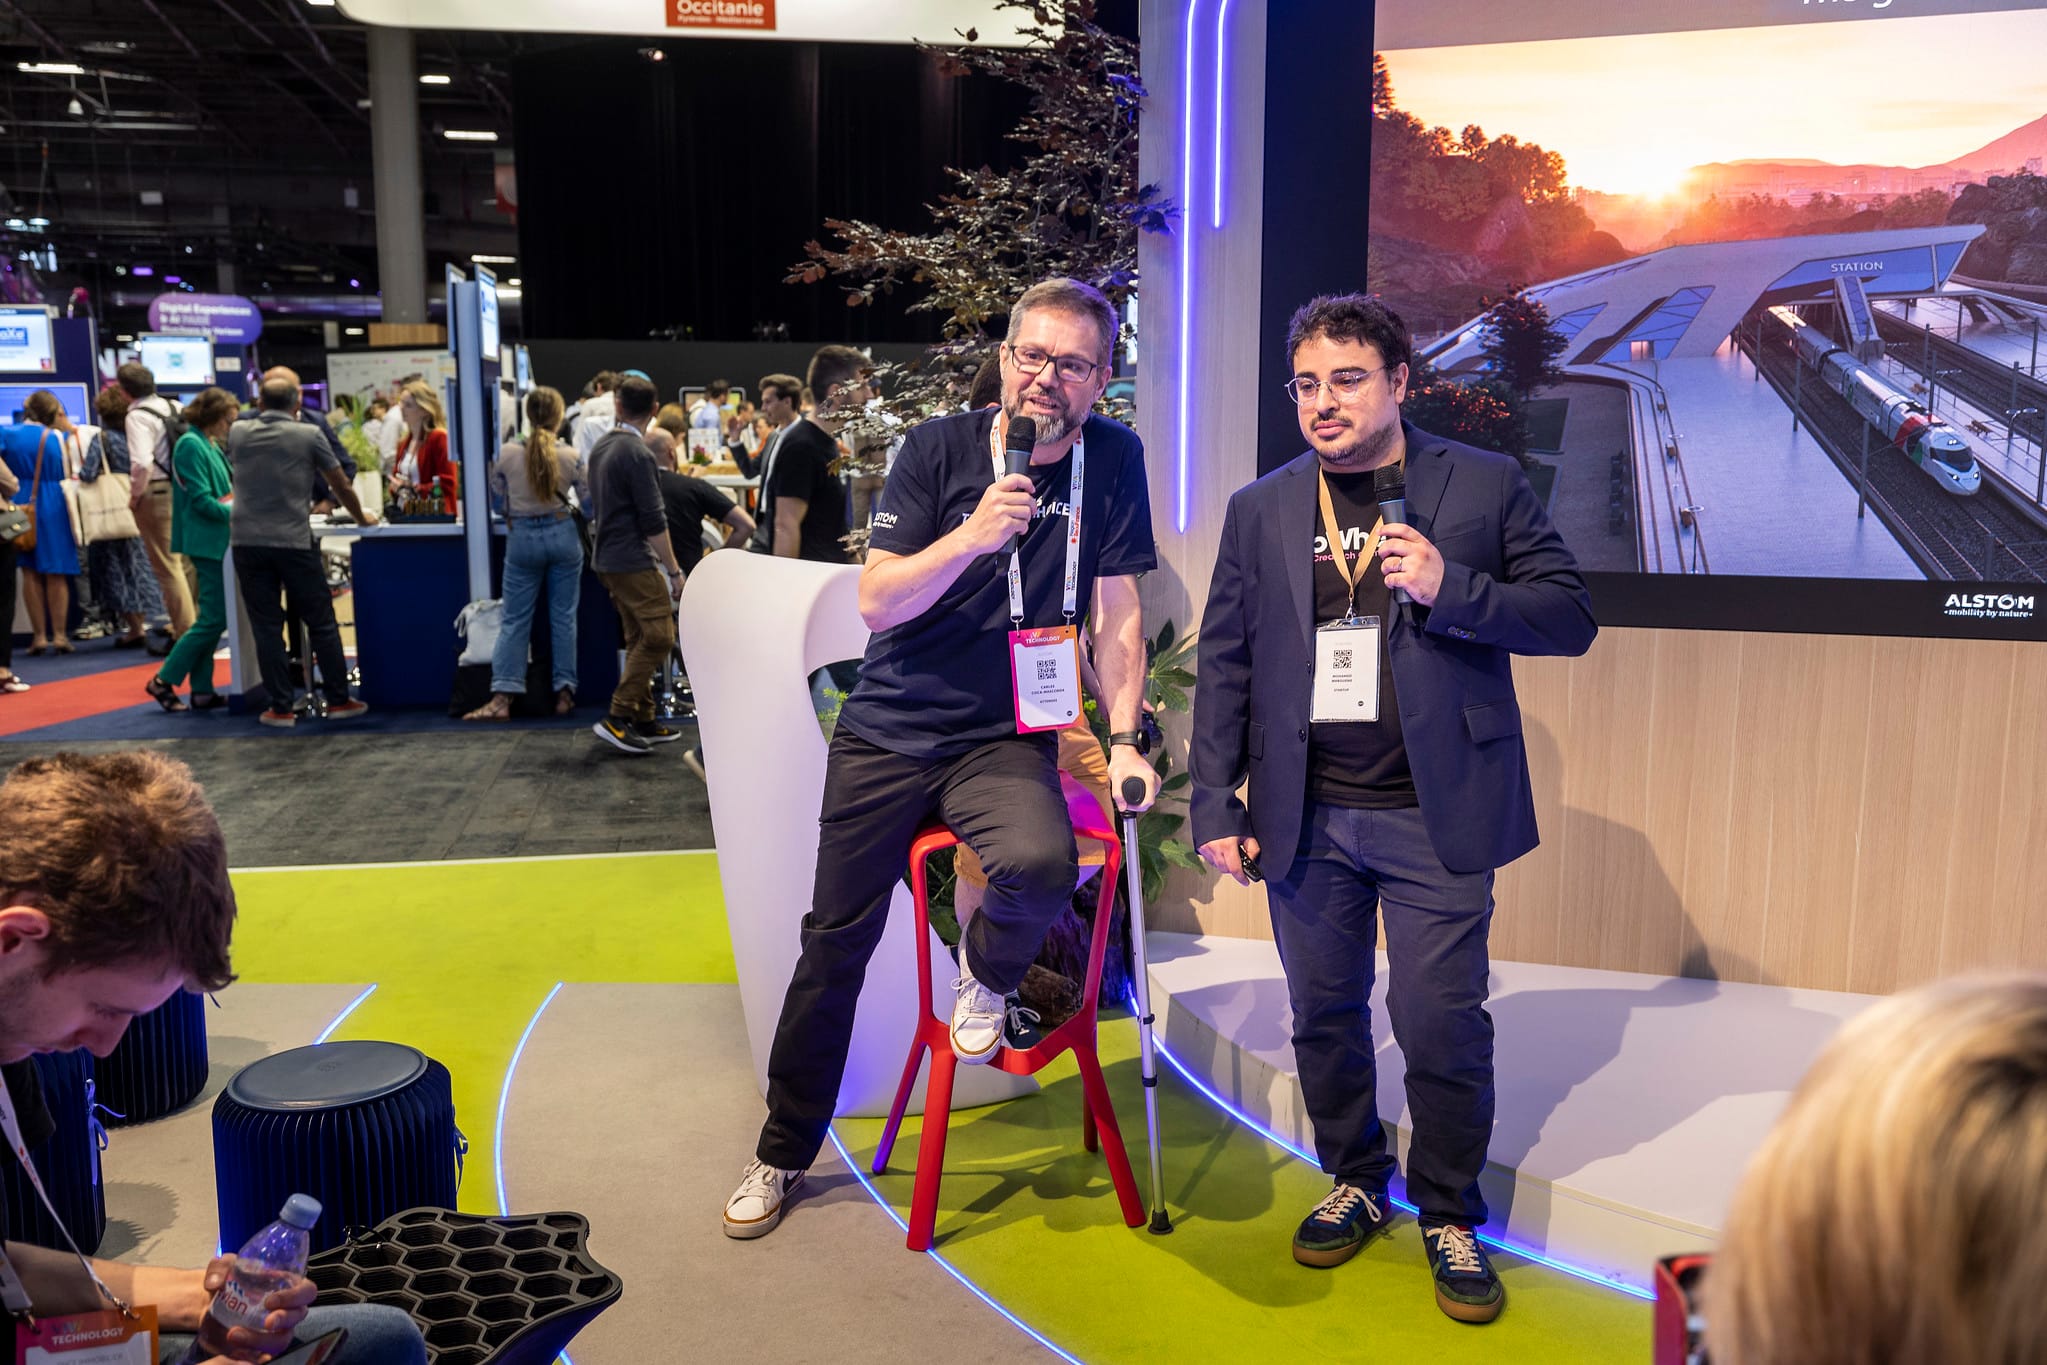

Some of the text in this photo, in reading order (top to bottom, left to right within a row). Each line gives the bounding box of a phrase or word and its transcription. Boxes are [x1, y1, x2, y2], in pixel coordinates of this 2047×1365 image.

[677, 0, 764, 16] Occitanie
[1831, 261, 1883, 272] STATION
[1945, 594, 2034, 609] ALSTOM
[1949, 608, 2028, 618] mobility by nature
[52, 1327, 123, 1345] TECHNOLOGY
